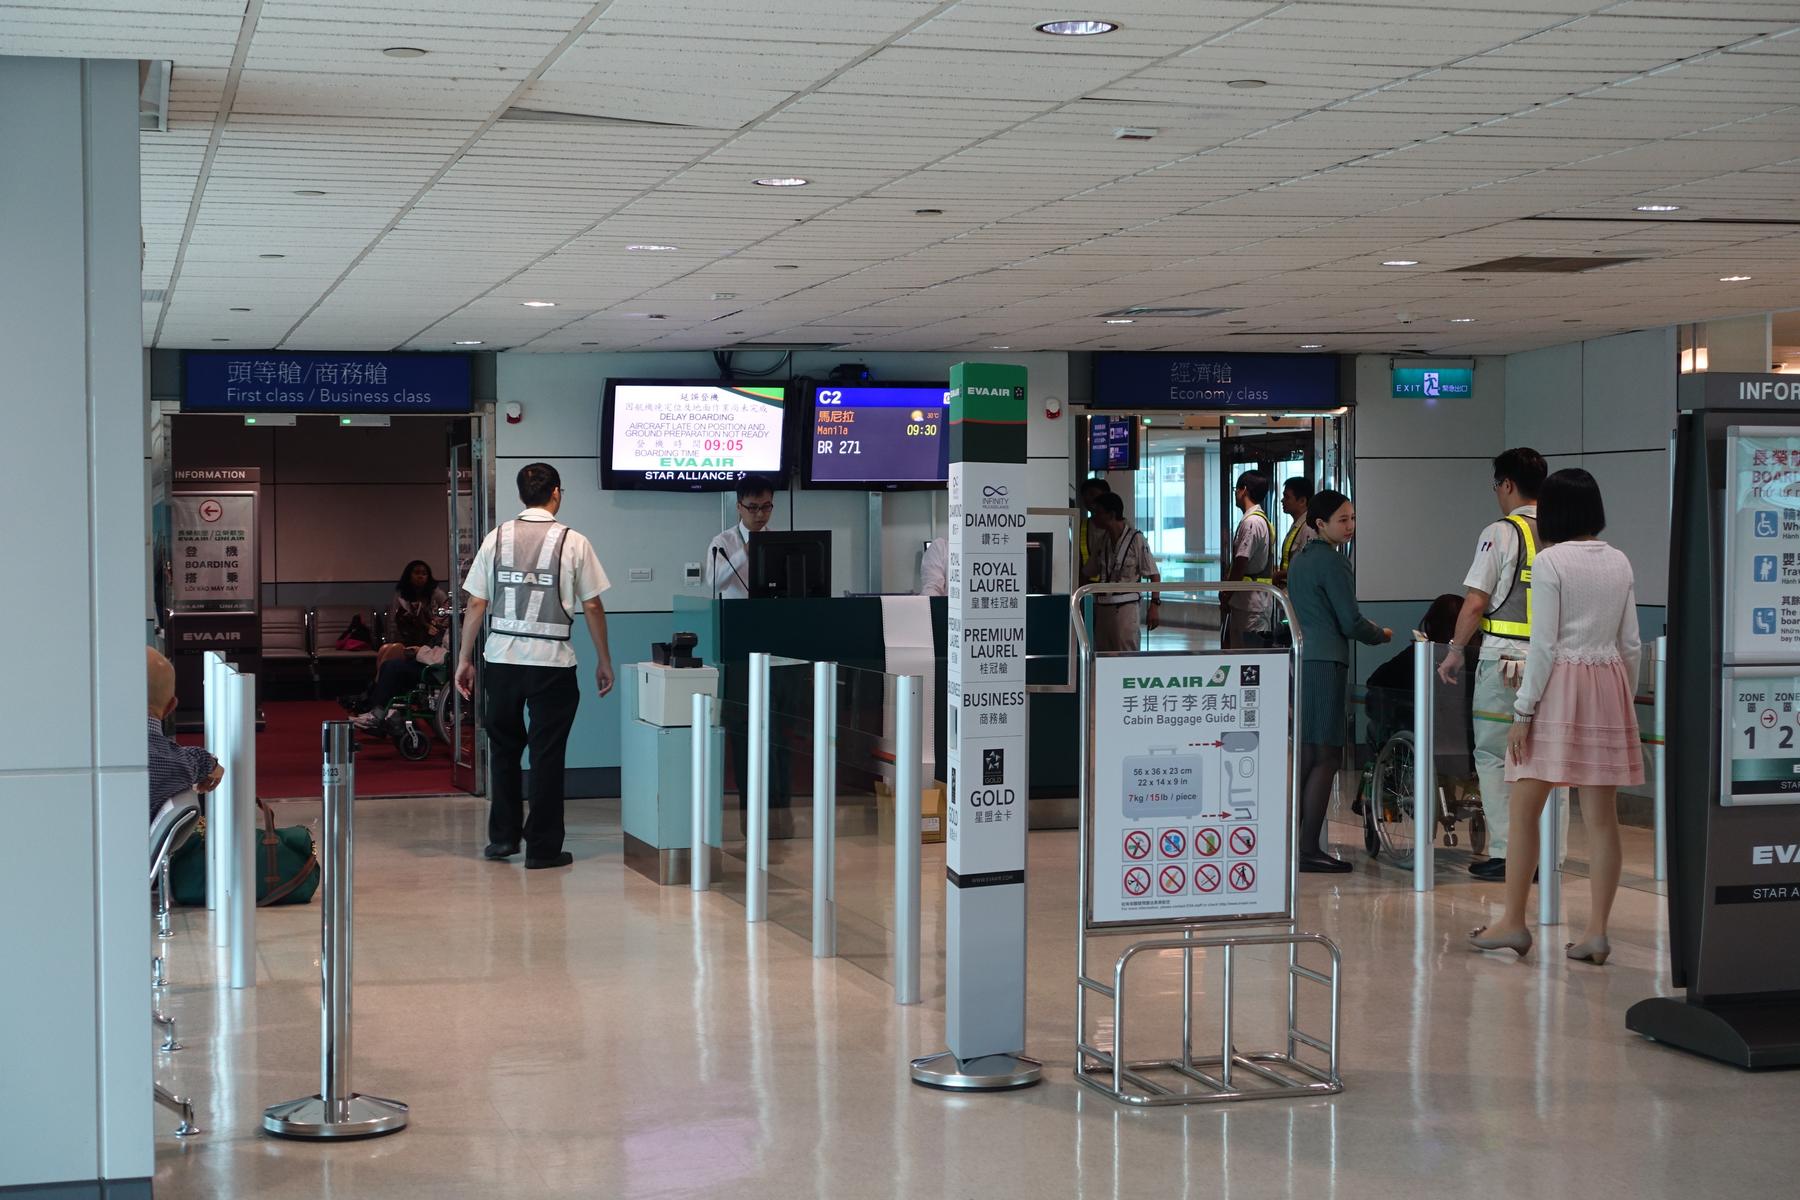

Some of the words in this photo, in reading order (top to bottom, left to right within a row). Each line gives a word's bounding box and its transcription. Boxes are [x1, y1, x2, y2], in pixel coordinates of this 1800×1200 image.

[227, 360, 388, 385] 頭等艙/商務艙
[1170, 362, 1233, 384] 經濟艙
[226, 387, 261, 402] First
[265, 387, 304, 402] class
[307, 387, 315, 403] /
[320, 388, 389, 403] Business
[393, 388, 431, 403] class
[1170, 386, 1233, 403] Economy
[1236, 386, 1269, 400] class
[1396, 384, 1421, 392] EXIT
[819, 390, 842, 405] C2
[660, 412, 687, 421] DELAY
[689, 413, 735, 422] BOARDING
[818, 410, 855, 423] 馬尼拉
[629, 422, 670, 430] AIRCRAFT
[671, 422, 691, 431] LATE
[693, 422, 707, 431] ON
[707, 423, 747, 431] POSITION
[817, 425, 849, 436] Manila
[906, 424, 937, 436] 09:30
[625, 430, 663, 438] GROUND
[663, 430, 721, 439] PREPARATION
[741, 431, 770, 439] READY
[704, 439, 744, 451] 09:05
[817, 440, 833, 454] BR
[839, 440, 861, 454] 271
[635, 449, 679, 457] BOARDING
[175, 470, 246, 479] INFORMATION
[645, 471, 675, 480] STAR
[677, 471, 734, 481] ALLIANCE
[965, 513, 1026, 528] DIAMOND
[1783, 522, 1800, 531] Wh
[185, 560, 239, 569] BOARDING
[972, 562, 1017, 576] ROYAL
[498, 571, 553, 585] EGAS
[970, 578, 1020, 593] LAUREL
[1781, 608, 1796, 616] The
[964, 627, 1024, 643] PREMIUM
[970, 644, 1018, 659] LAUREL
[963, 691, 1025, 708] BUSINESS
[1122, 692, 1237, 713] 手提行李須知
[1738, 693, 1765, 702] ZONE
[1775, 692, 1800, 702] ZONE
[979, 712, 1008, 726] 商務艙
[1123, 715, 1154, 725] Cabin
[1156, 714, 1202, 727] Baggage
[1205, 712, 1236, 723] Guide
[1743, 726, 1756, 750] 1
[1778, 725, 1794, 749] 2
[1133, 768, 1143, 776] 56
[1151, 767, 1161, 775] 36
[1169, 767, 1179, 775] 23
[1156, 778, 1165, 786] 14
[1173, 777, 1179, 785] 9
[1180, 777, 1188, 785] in
[970, 788, 1015, 807] GOLD
[1175, 792, 1197, 802] piece
[974, 809, 1013, 824] 星盟金卡
[1752, 887, 1788, 900] STAR
[1791, 886, 1800, 897] A
